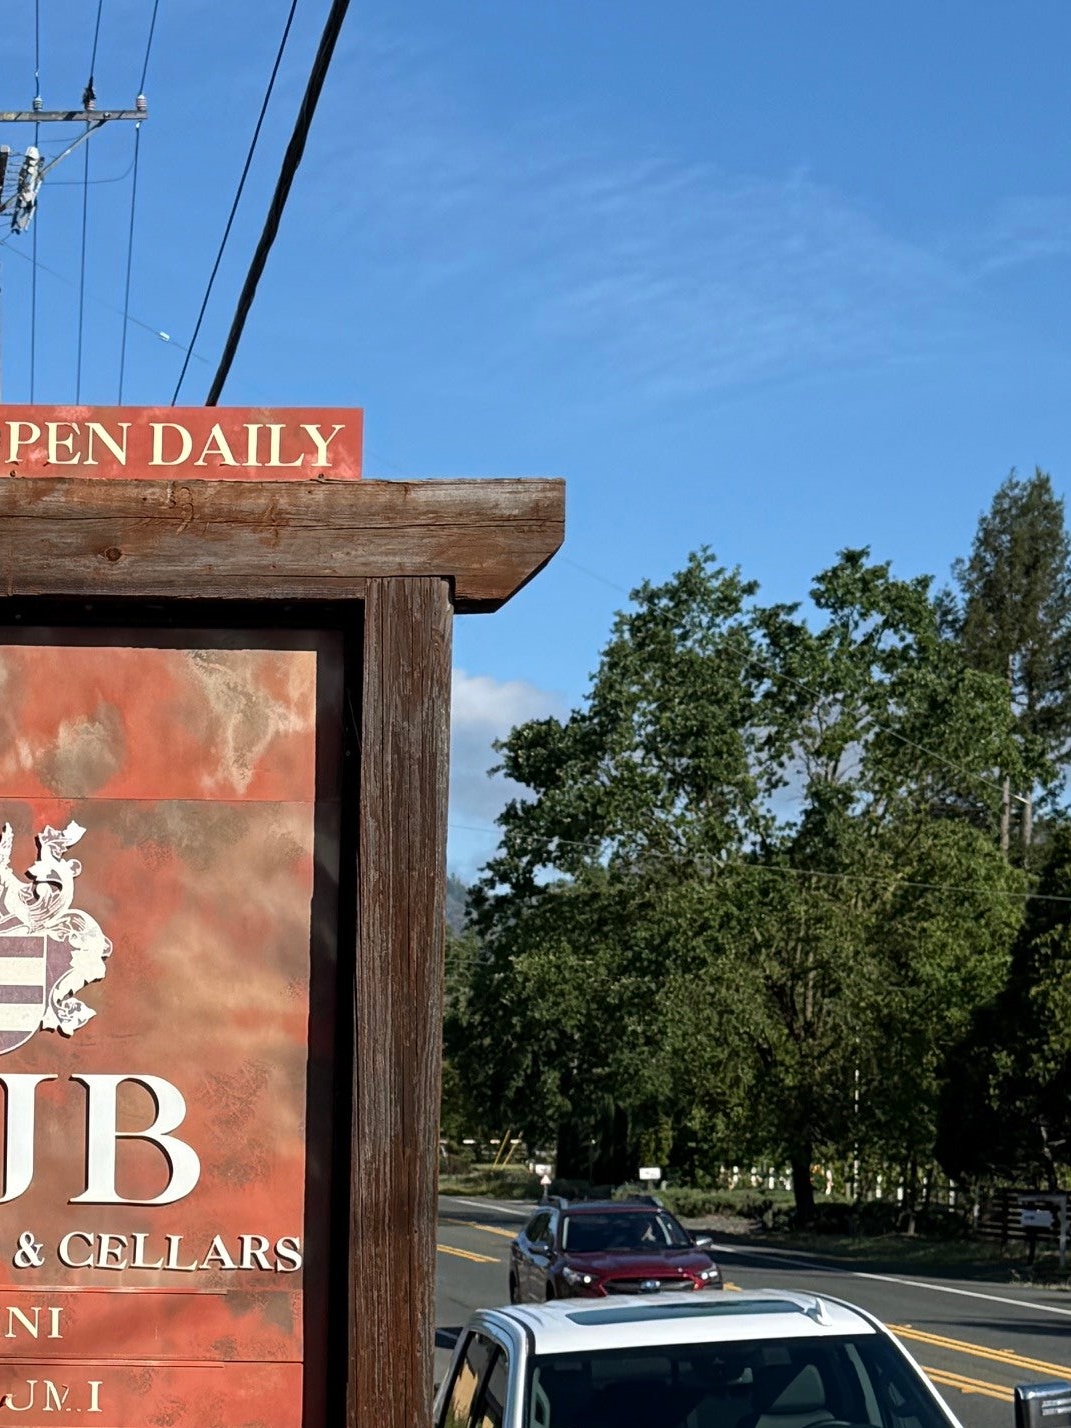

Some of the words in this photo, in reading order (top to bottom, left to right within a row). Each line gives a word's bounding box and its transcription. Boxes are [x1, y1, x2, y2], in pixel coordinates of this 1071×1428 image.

[148, 422, 346, 467] DAILY
[14, 1231, 45, 1268] &
[59, 1232, 303, 1272] CELLARS
